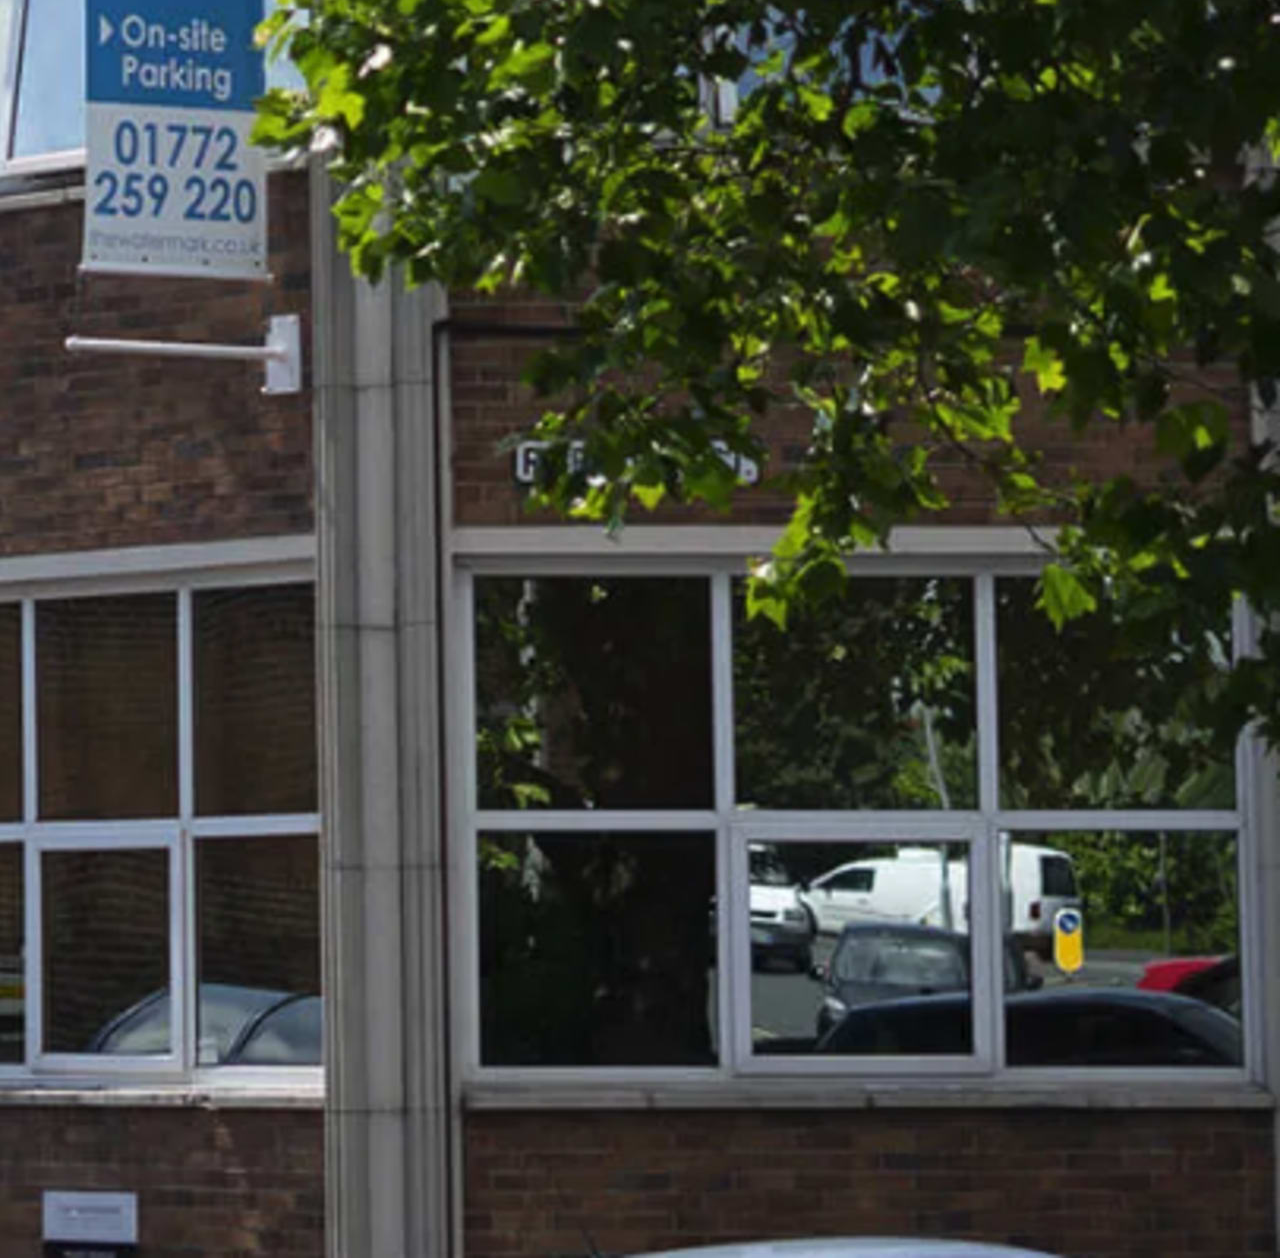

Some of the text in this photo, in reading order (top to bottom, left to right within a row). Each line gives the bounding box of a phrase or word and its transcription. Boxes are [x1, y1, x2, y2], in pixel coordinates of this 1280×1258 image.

[121, 15, 227, 53] On-site
[121, 59, 232, 101] Parking
[114, 119, 238, 173] 01772
[93, 172, 257, 224] 259 220
